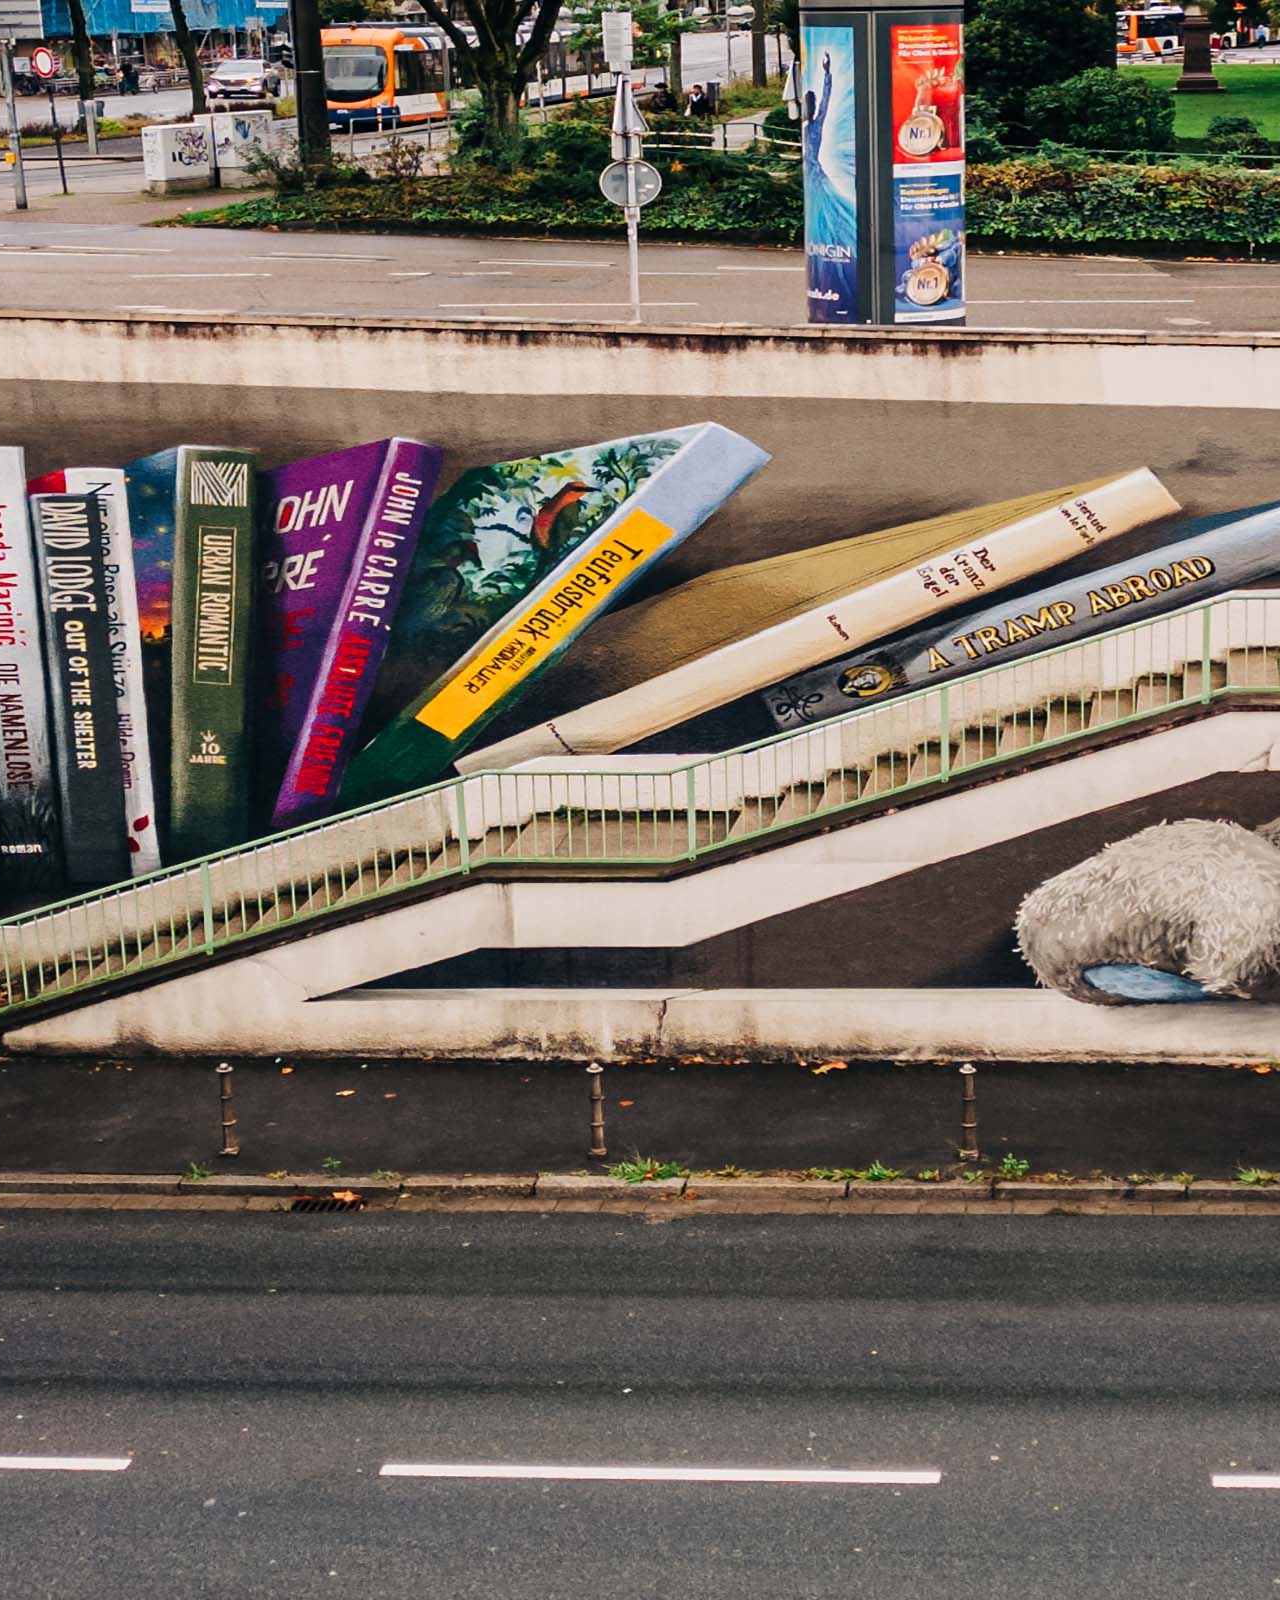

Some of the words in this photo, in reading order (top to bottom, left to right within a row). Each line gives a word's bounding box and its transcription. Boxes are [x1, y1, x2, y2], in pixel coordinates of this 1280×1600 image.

[273, 479, 356, 535] OHN
[381, 471, 423, 526] JOHN
[40, 502, 91, 550] DAVID
[373, 530, 406, 549] le
[45, 556, 97, 612] LODGE
[201, 533, 233, 586] URBAN
[917, 564, 950, 598] Engel
[939, 565, 960, 587] der
[951, 550, 986, 591] Kranz
[972, 546, 996, 572] Der
[347, 553, 399, 632] CARRÉ
[518, 539, 644, 641] Teufelsbrück
[926, 647, 953, 673] A
[953, 602, 1076, 661] TRAMP
[1088, 555, 1216, 617] ABROAD
[64, 619, 88, 652] OUT
[197, 591, 231, 672] ROMANTIC
[68, 656, 89, 677] OF
[463, 638, 526, 695] KRONAUER
[70, 677, 92, 707] THE
[73, 711, 97, 770] SHELTER
[199, 742, 220, 755] 10
